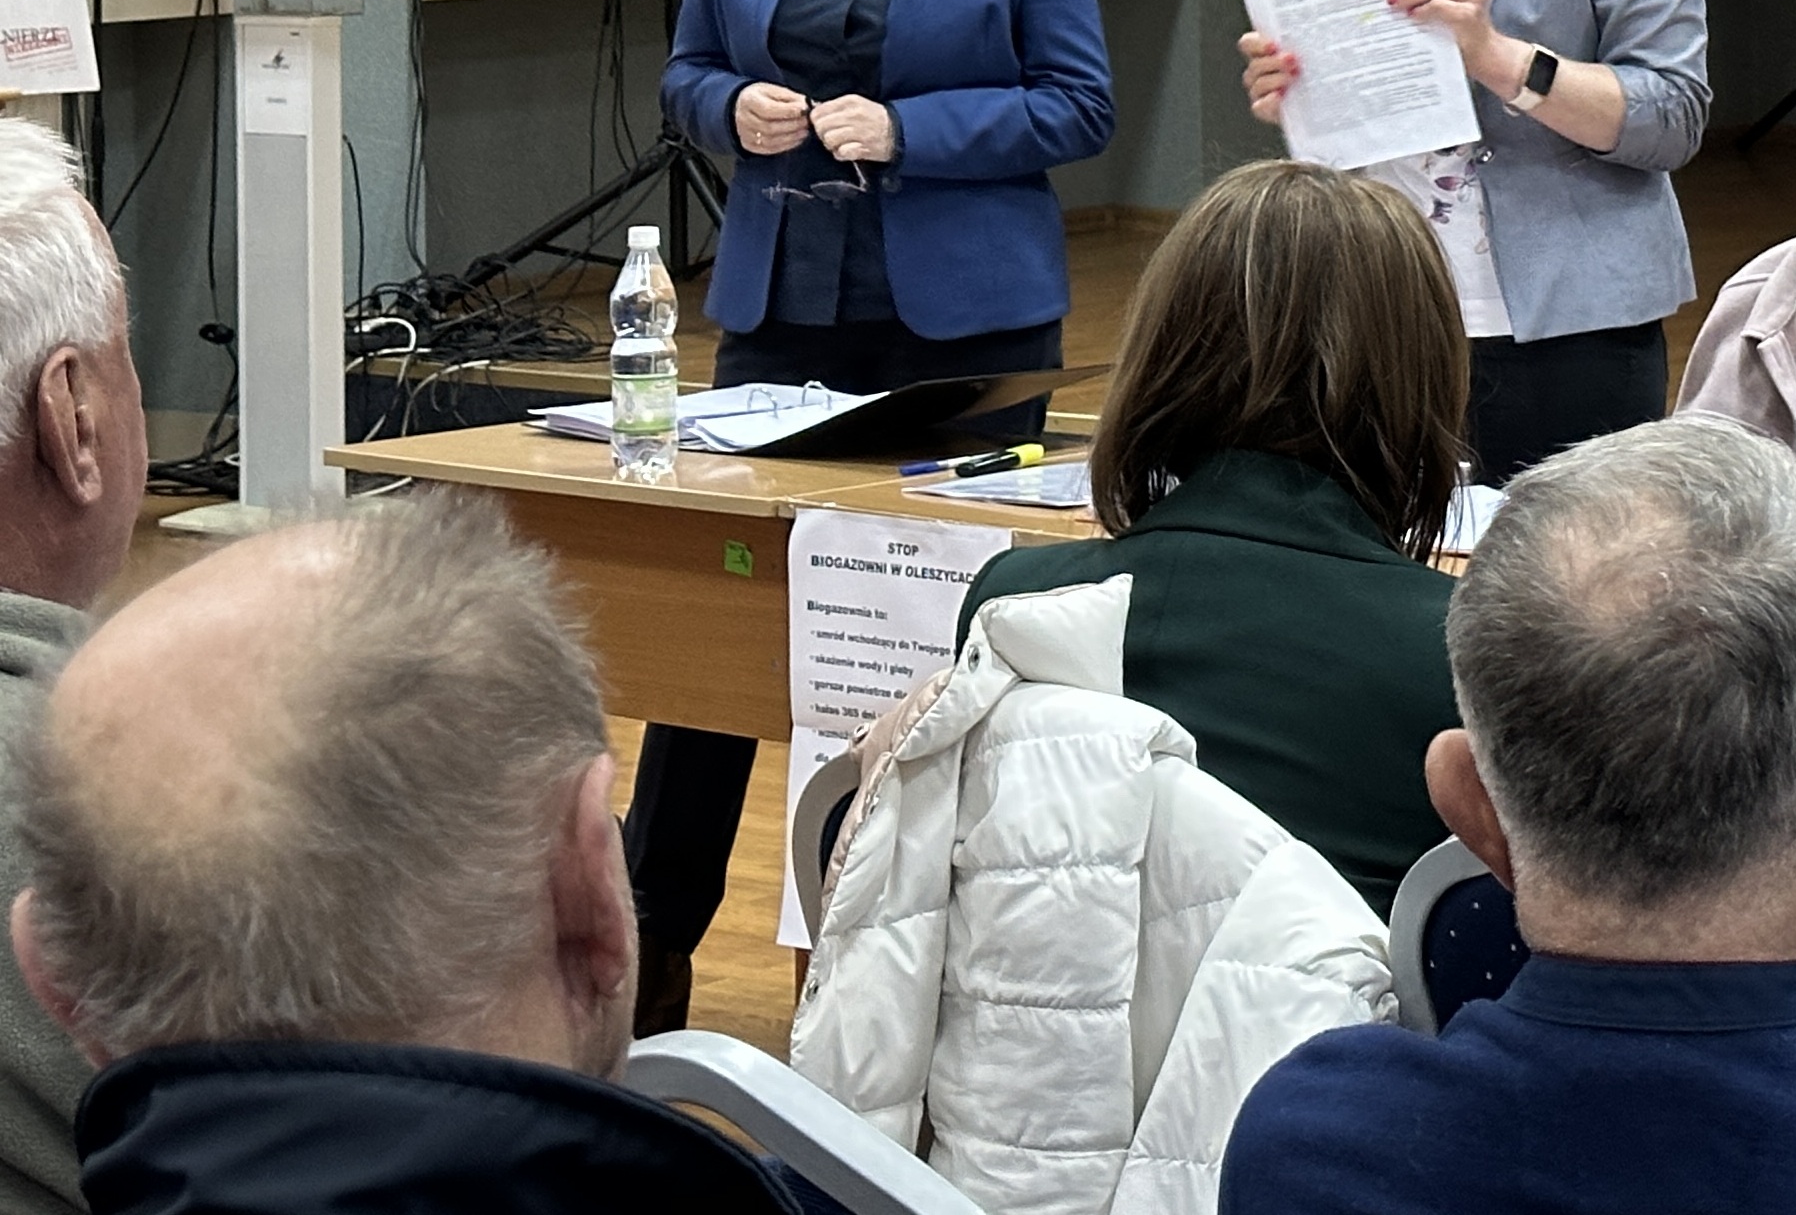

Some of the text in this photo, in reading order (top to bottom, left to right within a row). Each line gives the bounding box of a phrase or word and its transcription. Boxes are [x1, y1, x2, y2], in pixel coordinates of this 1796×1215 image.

[887, 542, 919, 557] STOP
[811, 555, 976, 585] BIOGAZOWNI W OLESZYCAC
[807, 600, 872, 619] Biogazownia
[898, 639, 910, 650] do
[911, 641, 950, 656] Twojego
[858, 660, 882, 673] wody
